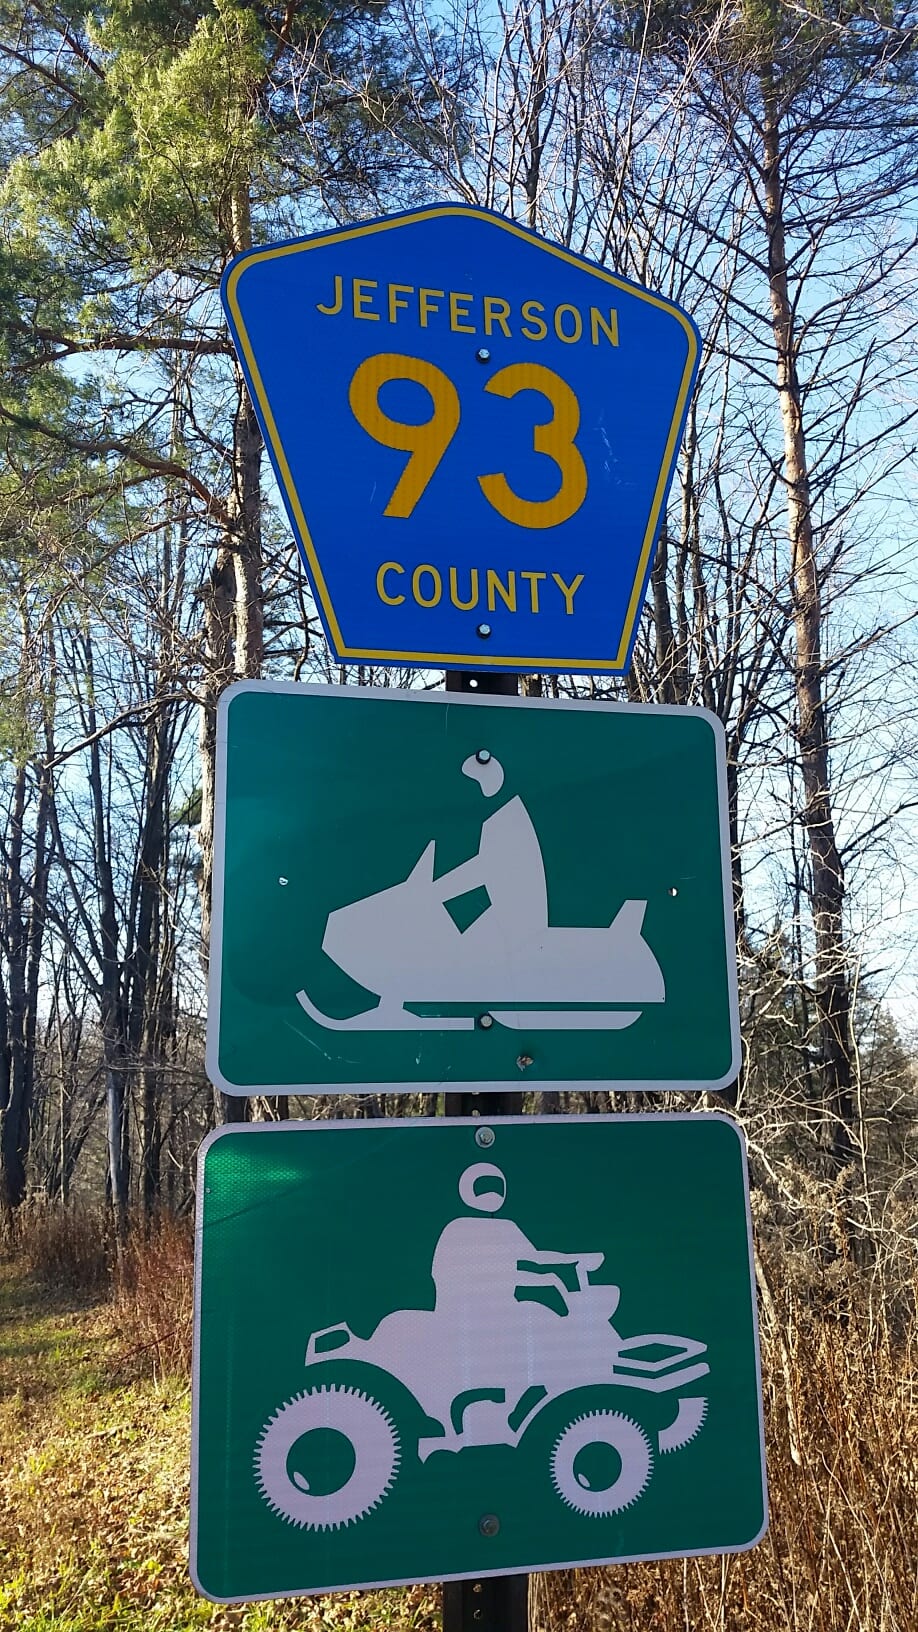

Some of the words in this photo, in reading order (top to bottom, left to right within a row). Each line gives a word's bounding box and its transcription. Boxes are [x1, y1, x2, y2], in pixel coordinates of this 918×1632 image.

[316, 275, 620, 347] JEFFERSON
[348, 352, 589, 529] 93
[376, 561, 585, 615] COUNTY
